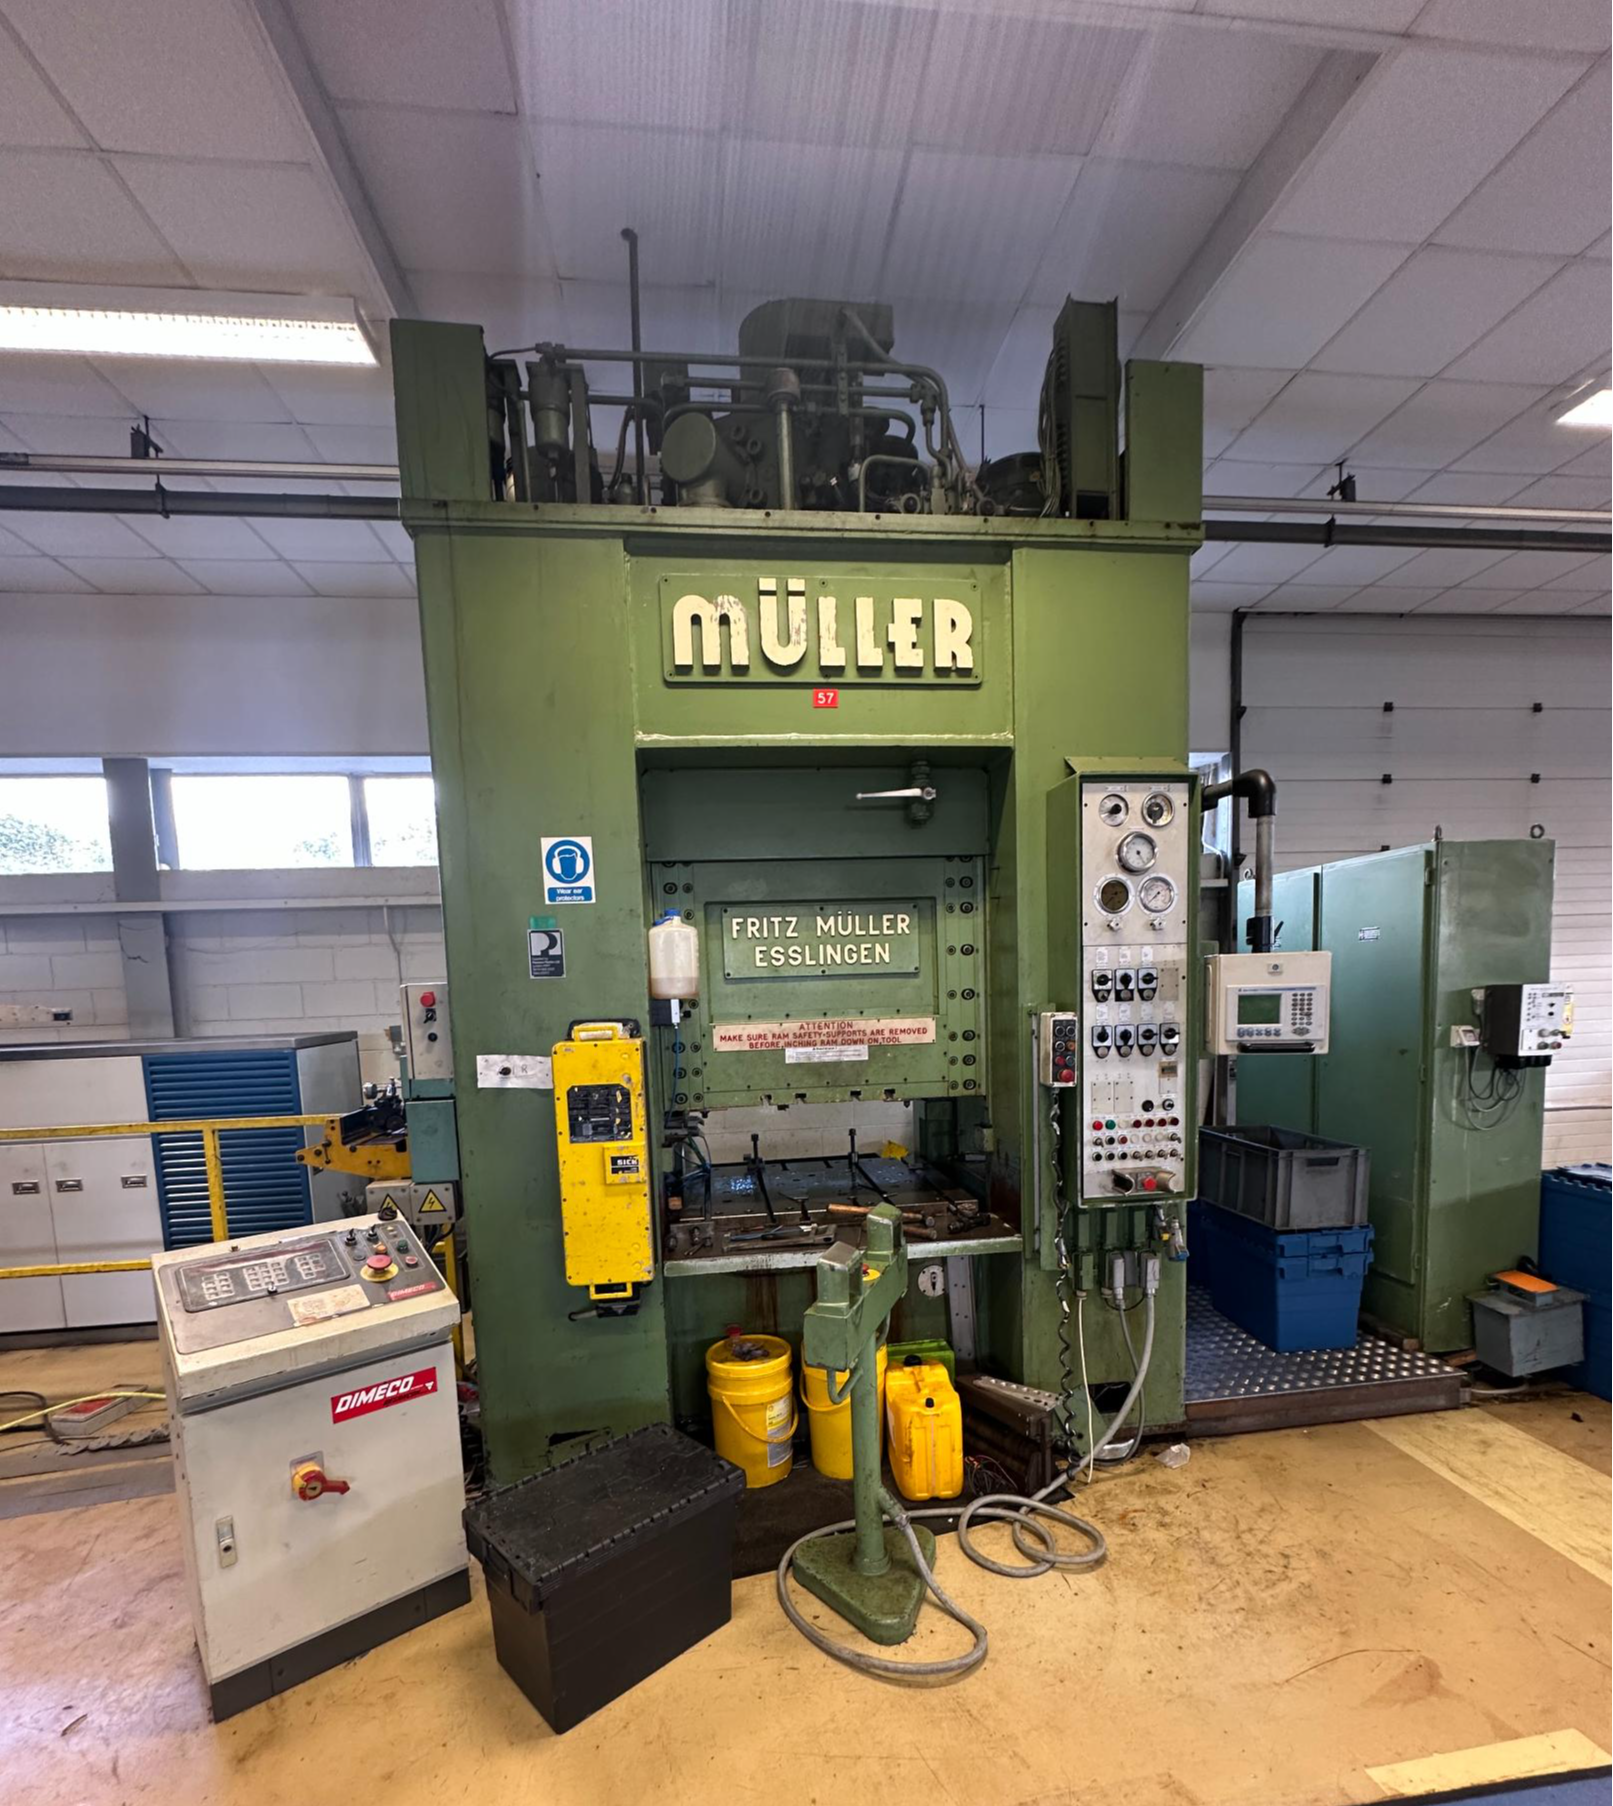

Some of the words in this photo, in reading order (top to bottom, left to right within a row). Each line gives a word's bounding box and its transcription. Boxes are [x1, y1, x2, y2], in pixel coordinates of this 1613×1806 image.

[672, 577, 974, 673] MÜLLER
[817, 692, 835, 704] 57
[731, 916, 799, 939] FRITZ
[816, 911, 911, 937] MÜLLER
[754, 942, 891, 968] ESSLINGEN
[719, 1034, 743, 1042] MAKE
[746, 1032, 769, 1042] SURE
[771, 1032, 790, 1040] RAM
[870, 1028, 886, 1037] ARE
[889, 1026, 928, 1036] REMOVED
[798, 1021, 854, 1031] ATTENTION
[748, 1040, 779, 1050] BEFORE
[784, 1038, 818, 1048] INCHING
[820, 1038, 838, 1047] RAM
[841, 1037, 866, 1046] DOWN
[867, 1036, 879, 1045] ON
[881, 1036, 902, 1044] TOOL
[617, 1158, 638, 1166] SICK
[334, 1375, 415, 1414] DIMECO
